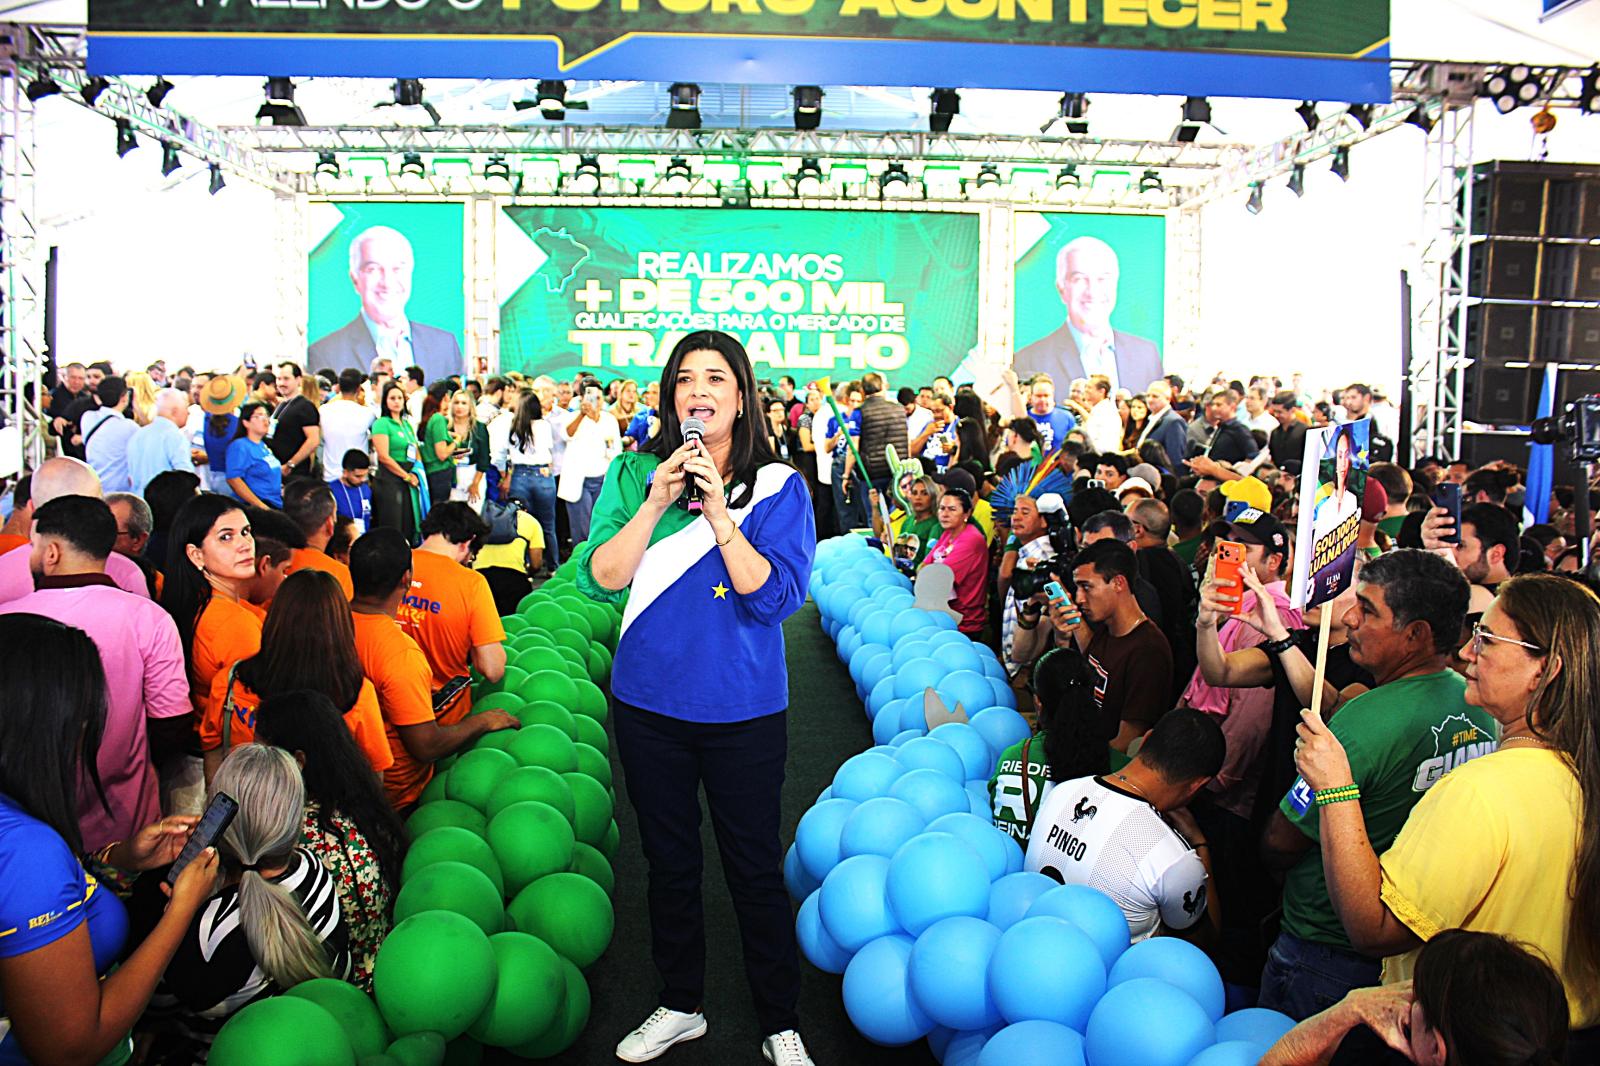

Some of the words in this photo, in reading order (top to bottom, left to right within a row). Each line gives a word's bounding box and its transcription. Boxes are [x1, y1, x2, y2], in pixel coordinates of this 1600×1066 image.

[637, 251, 844, 281] REALIZAMOS
[619, 278, 692, 312] DE
[697, 279, 804, 313] 500
[811, 280, 904, 315] MIL
[717, 312, 768, 331] PARA
[769, 313, 786, 331] O
[787, 314, 879, 332] MERCADO
[879, 315, 906, 332] DE
[567, 329, 911, 370] TRAALHO
[1309, 544, 1341, 578] LUANA
[1341, 523, 1360, 552] RUIZ
[1314, 530, 1337, 558] SOU
[1451, 727, 1478, 747] #TIME
[1046, 824, 1087, 861] PINGO
